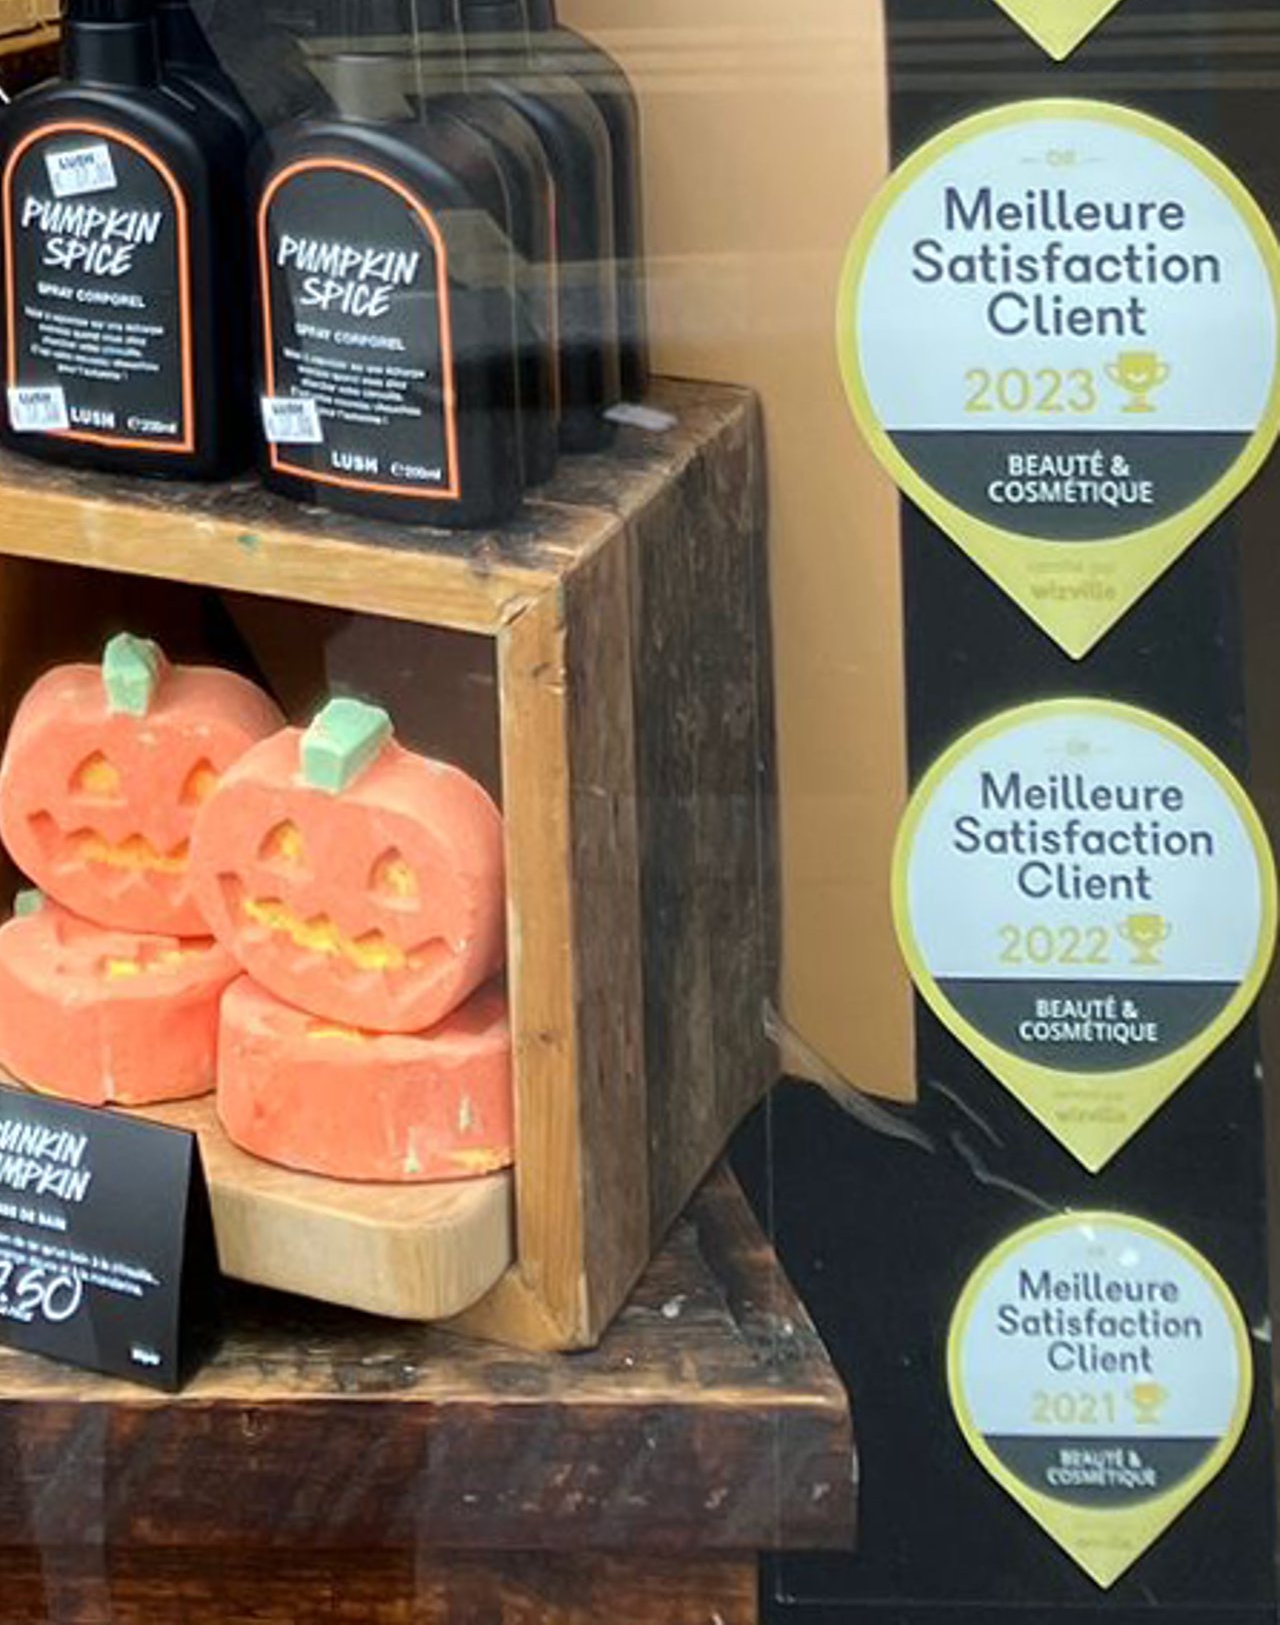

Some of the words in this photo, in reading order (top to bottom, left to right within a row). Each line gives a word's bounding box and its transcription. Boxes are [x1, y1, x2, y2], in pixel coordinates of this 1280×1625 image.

[21, 196, 161, 245] PUMPKIN
[944, 187, 1185, 231] Meilleure
[42, 236, 135, 277] SPICE
[277, 235, 418, 285] PUMPKIN
[911, 239, 1221, 284] Satisfaction
[37, 281, 74, 300] SPRAY
[76, 288, 146, 308] CORPOREL
[299, 278, 394, 318] SPICE
[295, 322, 331, 341] SPRAY
[986, 291, 1148, 337] Client
[963, 367, 1097, 413] 2023
[70, 406, 115, 428] LUSH
[331, 451, 378, 474] LUSH
[1008, 450, 1104, 477] BEAUTÉ
[1110, 455, 1131, 477] &
[988, 478, 1154, 506] COSMÉTIQUE
[980, 772, 1184, 812] Meilleure
[953, 816, 1214, 856] Satisfaction
[1017, 862, 1153, 900] Client
[998, 925, 1111, 964] 2022
[1036, 996, 1116, 1019] BEAUTÉ
[1122, 1002, 1138, 1019] &
[1019, 1018, 1159, 1043] COSMÉTIQUE
[1018, 1269, 1178, 1303] Meilleure
[998, 1305, 1203, 1339] Satisfaction
[1047, 1341, 1153, 1374] Client
[1032, 1390, 1117, 1424] 2021
